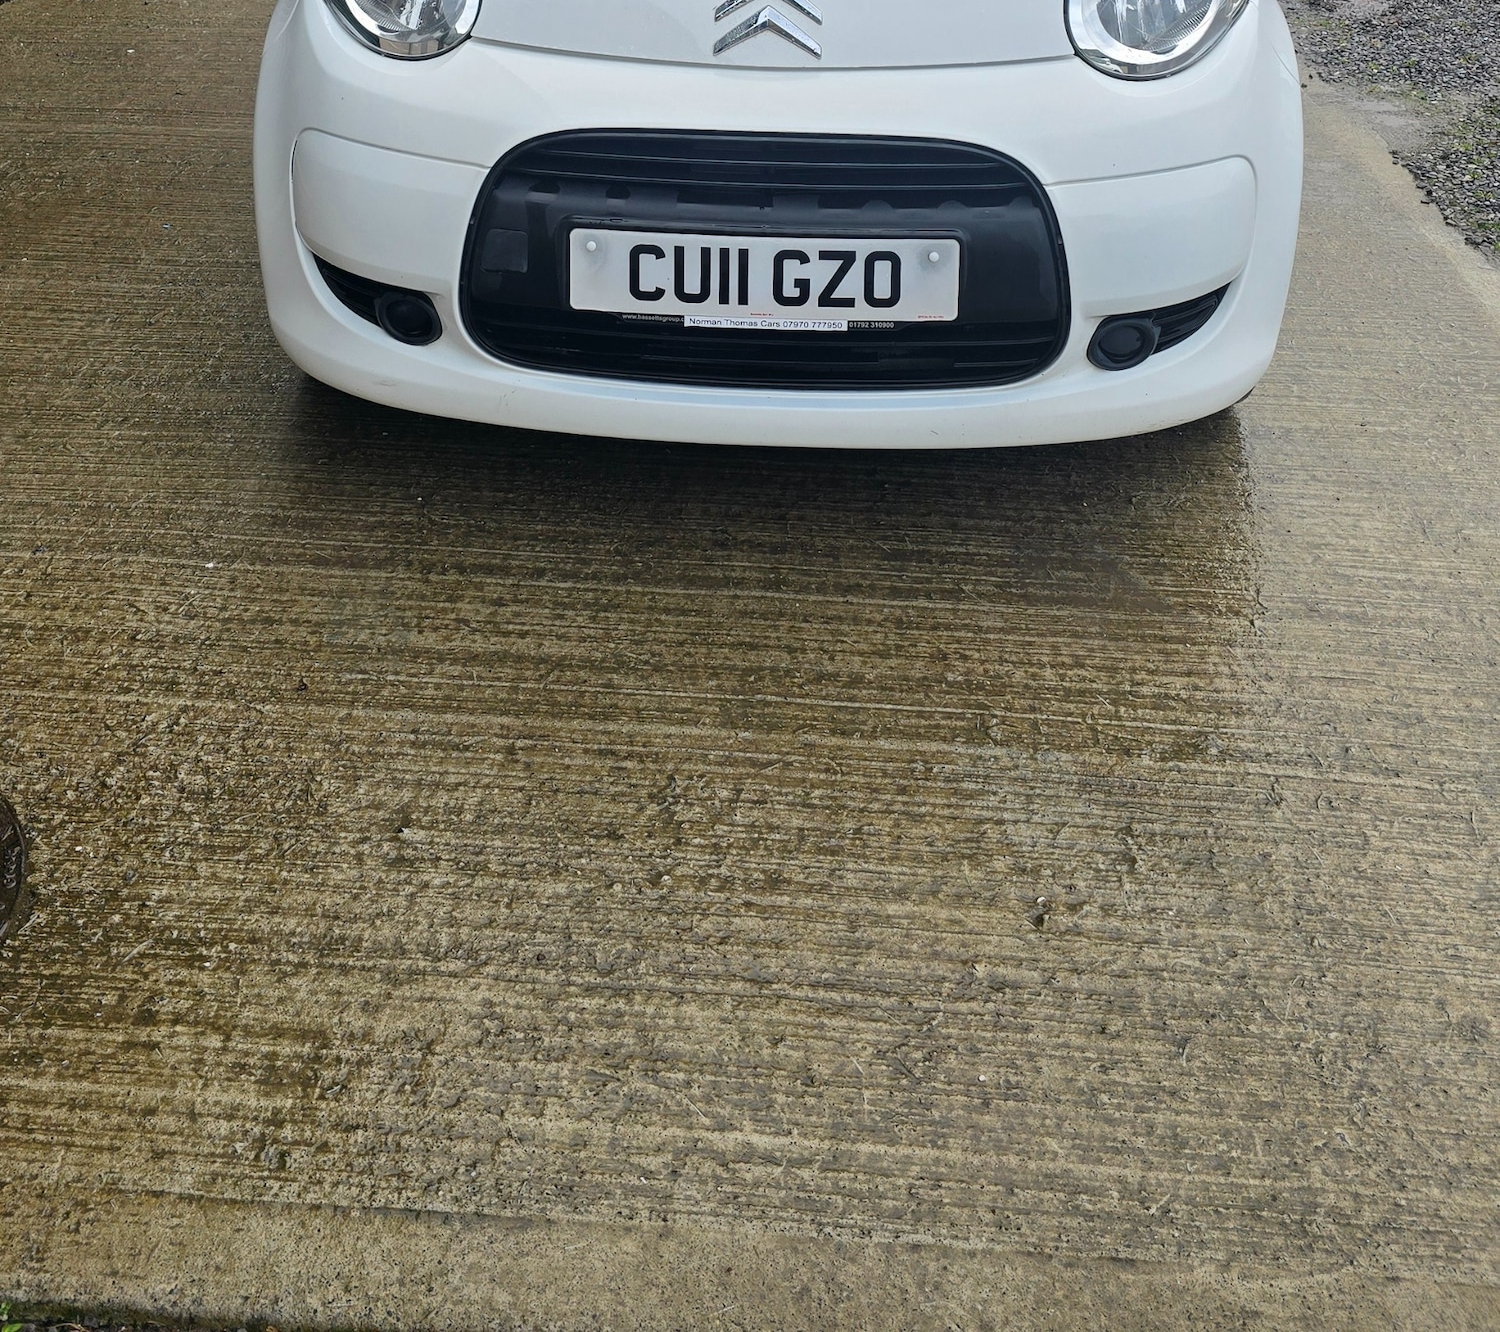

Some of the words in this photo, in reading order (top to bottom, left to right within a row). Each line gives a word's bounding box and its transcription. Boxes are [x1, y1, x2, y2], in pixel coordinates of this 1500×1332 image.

[628, 243, 749, 306] CU11
[772, 249, 901, 308] GZO
[689, 317, 722, 326] Norman
[724, 319, 758, 327] Thomas
[760, 320, 780, 328] Cars
[783, 320, 809, 328] 07970
[811, 321, 843, 329] 777950
